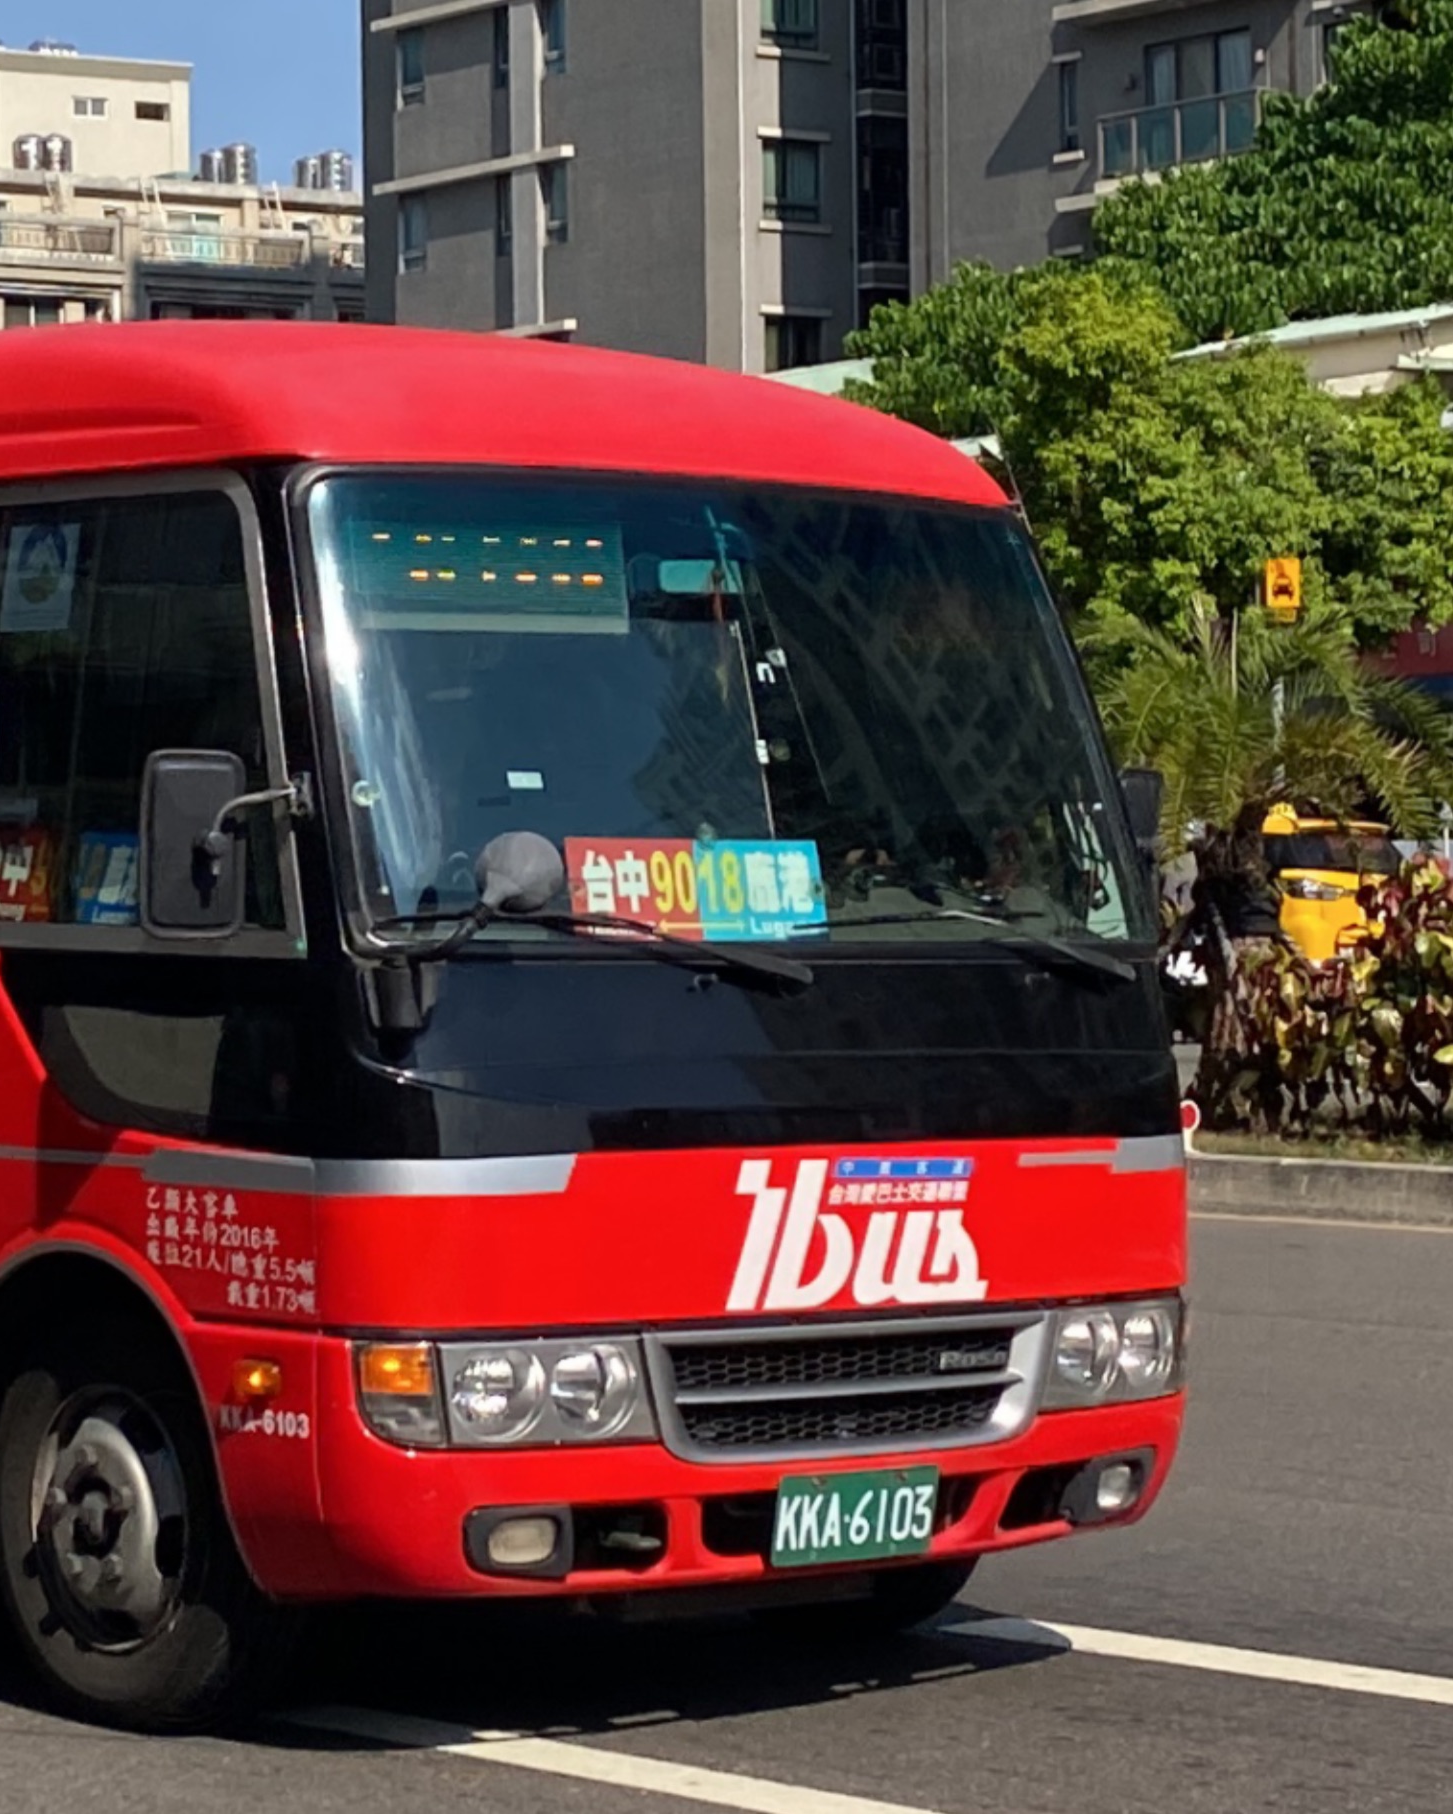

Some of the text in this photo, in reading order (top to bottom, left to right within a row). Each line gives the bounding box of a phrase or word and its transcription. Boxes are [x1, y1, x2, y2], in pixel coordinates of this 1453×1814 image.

[581, 850, 650, 914] 台中
[650, 850, 745, 914] 9018
[219, 1404, 310, 1439] KKA-6103
